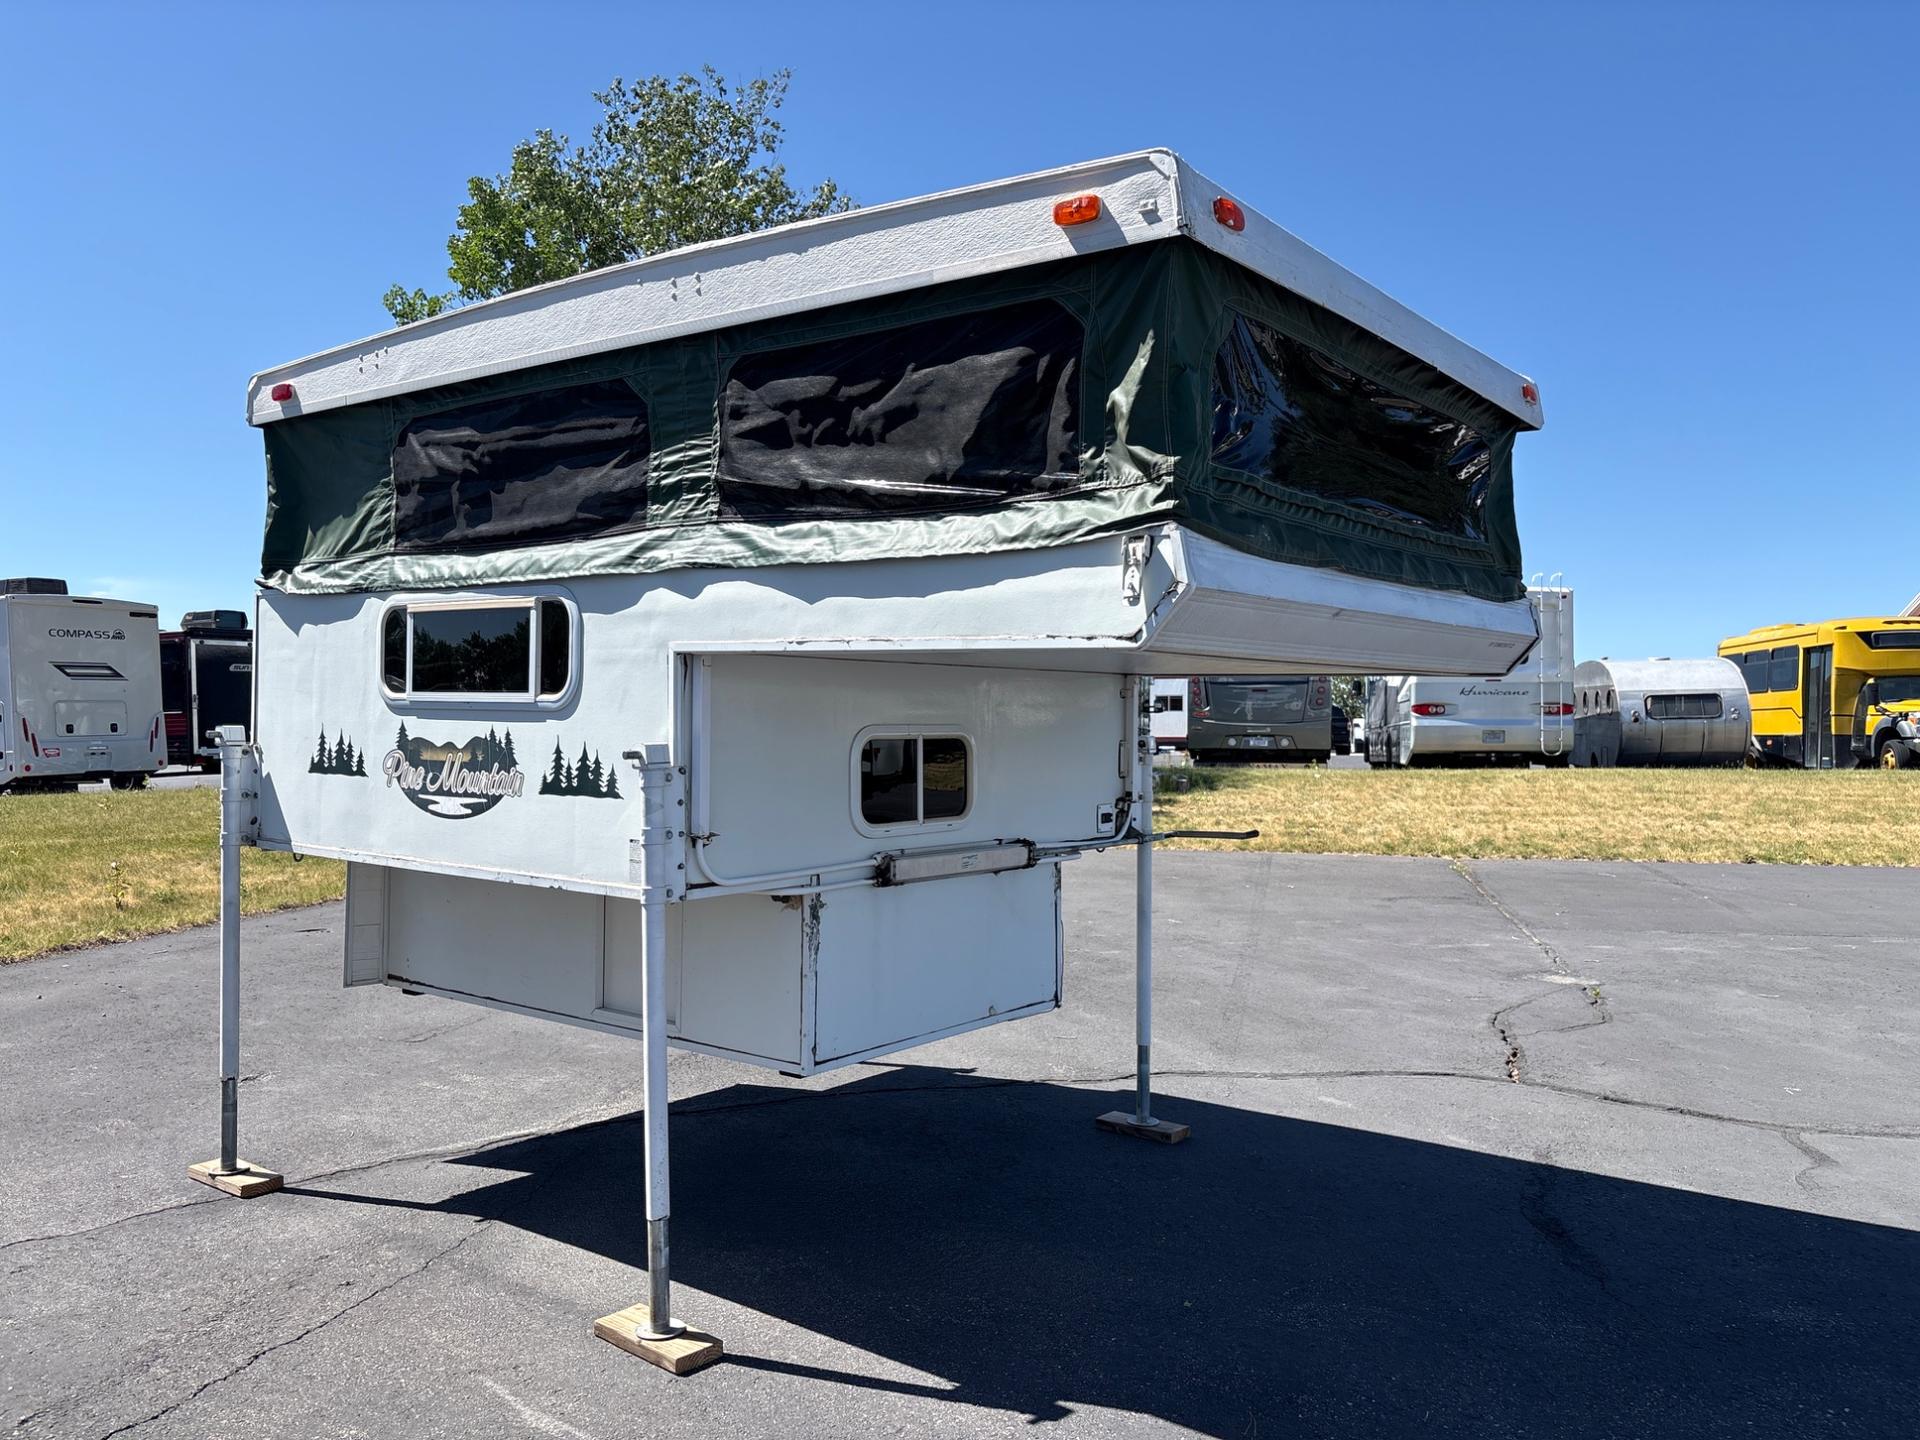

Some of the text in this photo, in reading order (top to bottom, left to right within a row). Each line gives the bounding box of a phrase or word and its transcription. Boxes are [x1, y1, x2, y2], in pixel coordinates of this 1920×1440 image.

[48, 628, 111, 640] COMPASS
[1459, 685, 1530, 696] Hurricane
[383, 749, 525, 797] Pine Mountain
